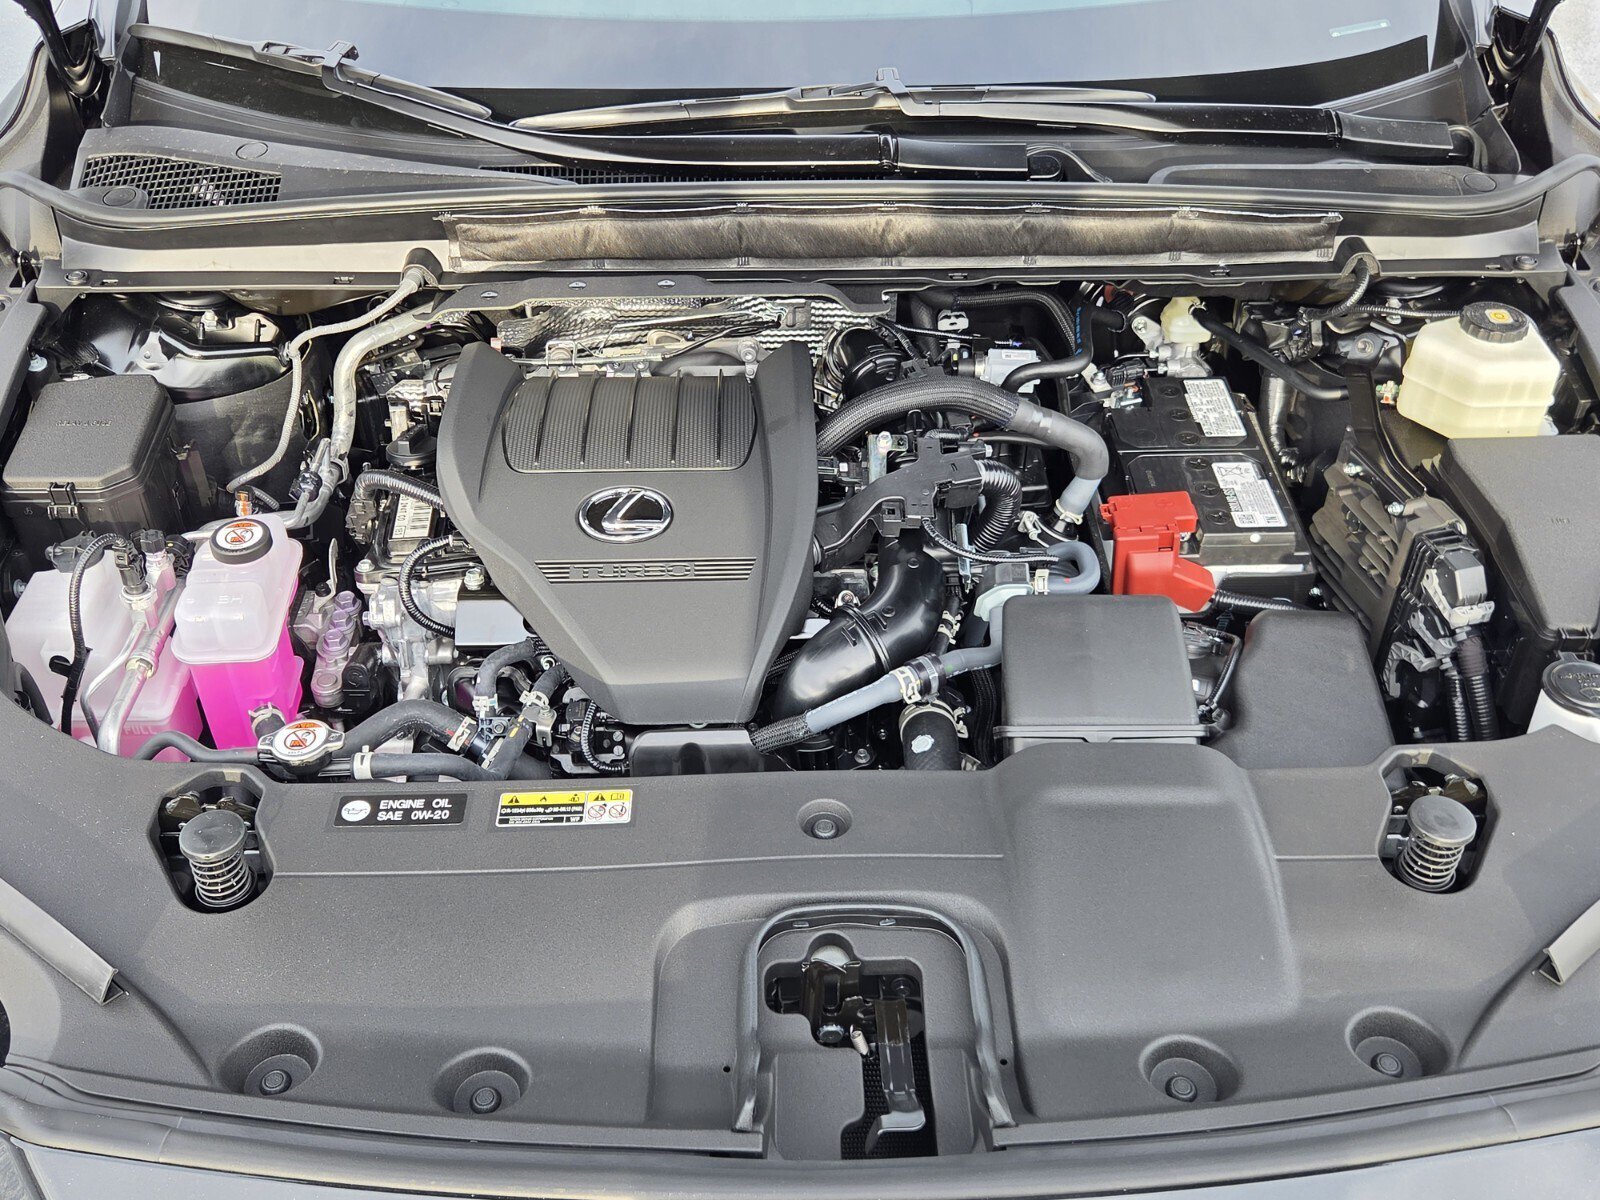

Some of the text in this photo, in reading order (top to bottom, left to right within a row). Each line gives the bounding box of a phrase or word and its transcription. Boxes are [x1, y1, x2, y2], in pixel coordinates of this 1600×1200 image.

[573, 563, 691, 578] TURBO
[123, 725, 158, 736] FULL
[379, 798, 452, 810] ENGINE OIL
[377, 809, 450, 821] SAE 0W-20
